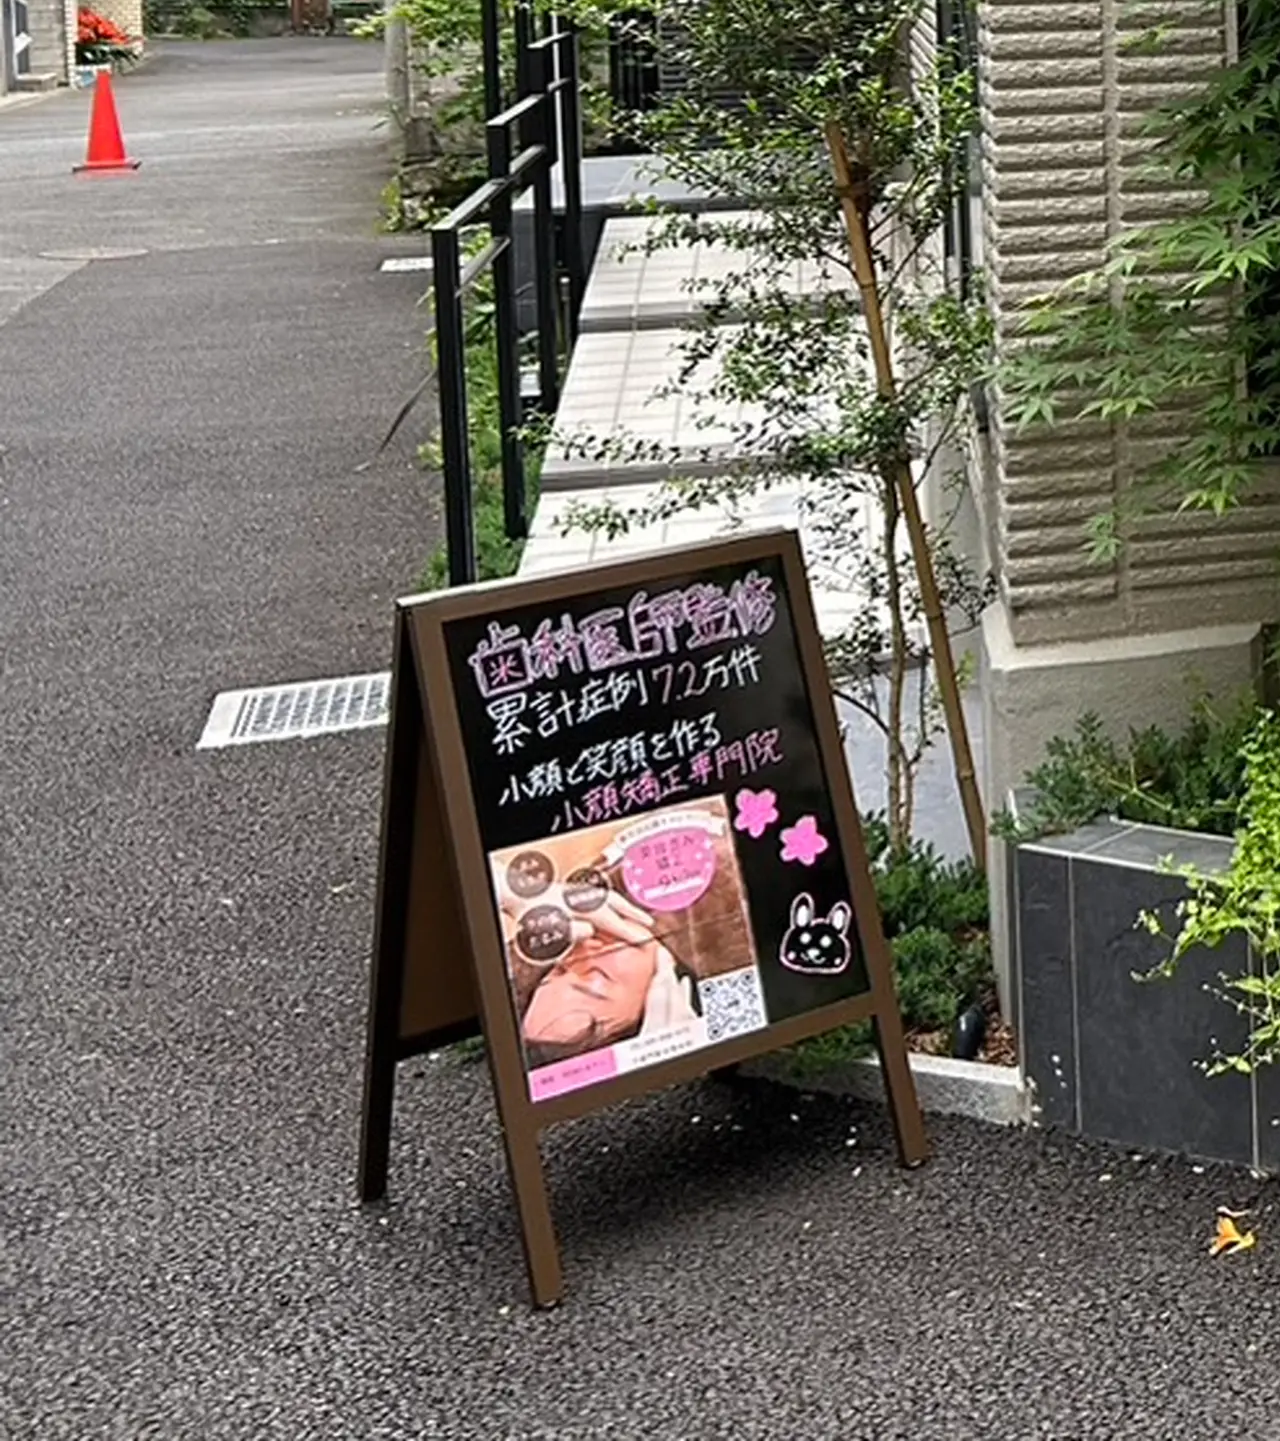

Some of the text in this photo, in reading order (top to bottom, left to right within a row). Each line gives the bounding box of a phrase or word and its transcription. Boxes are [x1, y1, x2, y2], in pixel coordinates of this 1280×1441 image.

[468, 570, 776, 697] 歯科医師監修
[499, 712, 721, 806] 小顔と笑顔を作る
[550, 727, 784, 833] 小顔矯正専門院
